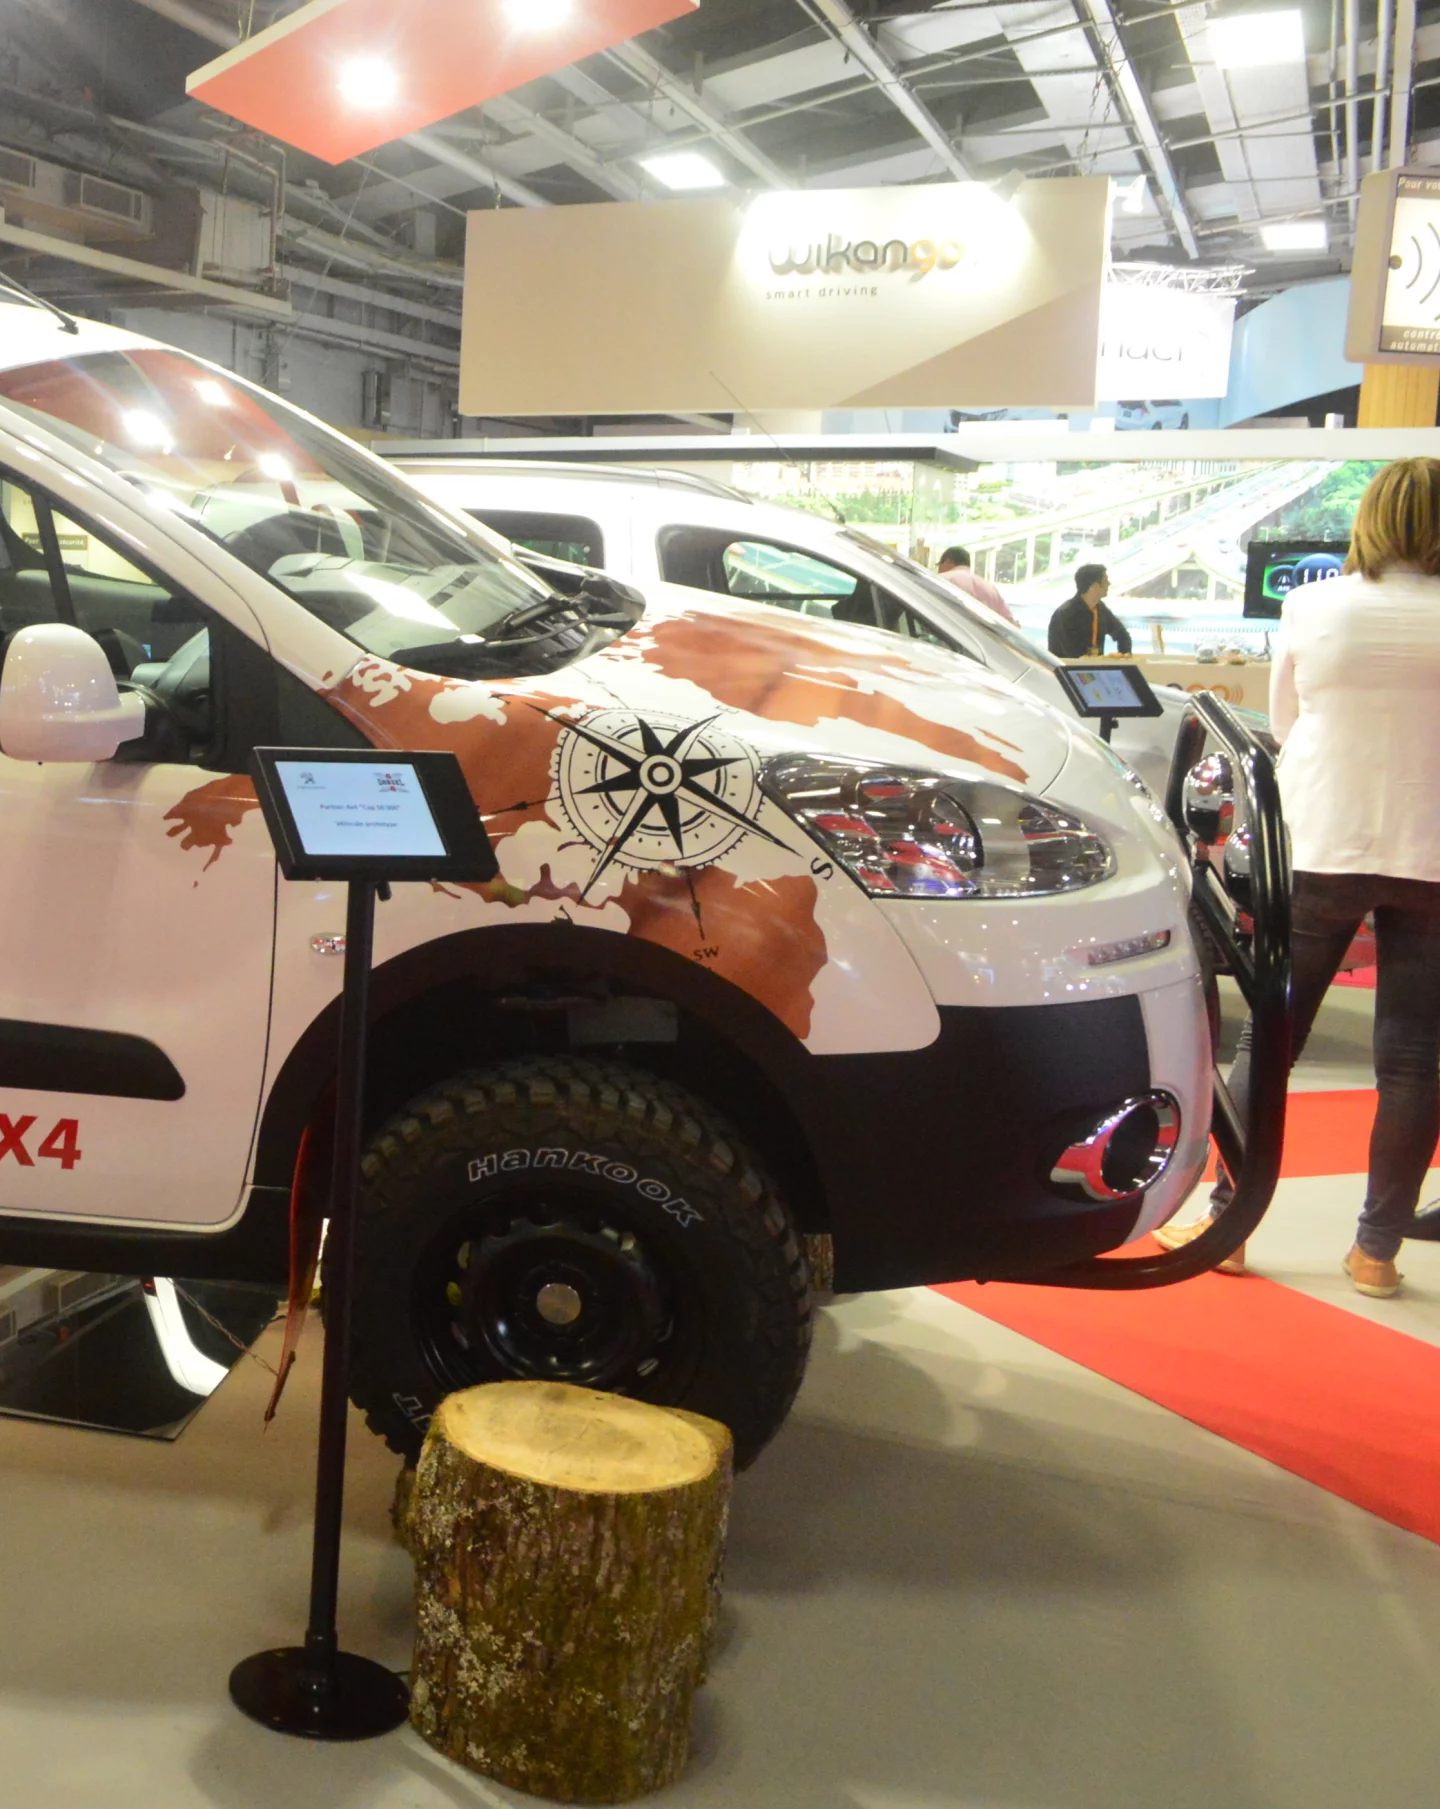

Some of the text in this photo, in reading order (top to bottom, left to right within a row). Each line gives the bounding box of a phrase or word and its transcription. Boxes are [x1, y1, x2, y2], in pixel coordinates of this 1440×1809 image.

[768, 233, 964, 277] wikango
[766, 285, 879, 300] smart driving
[692, 946, 720, 962] SW
